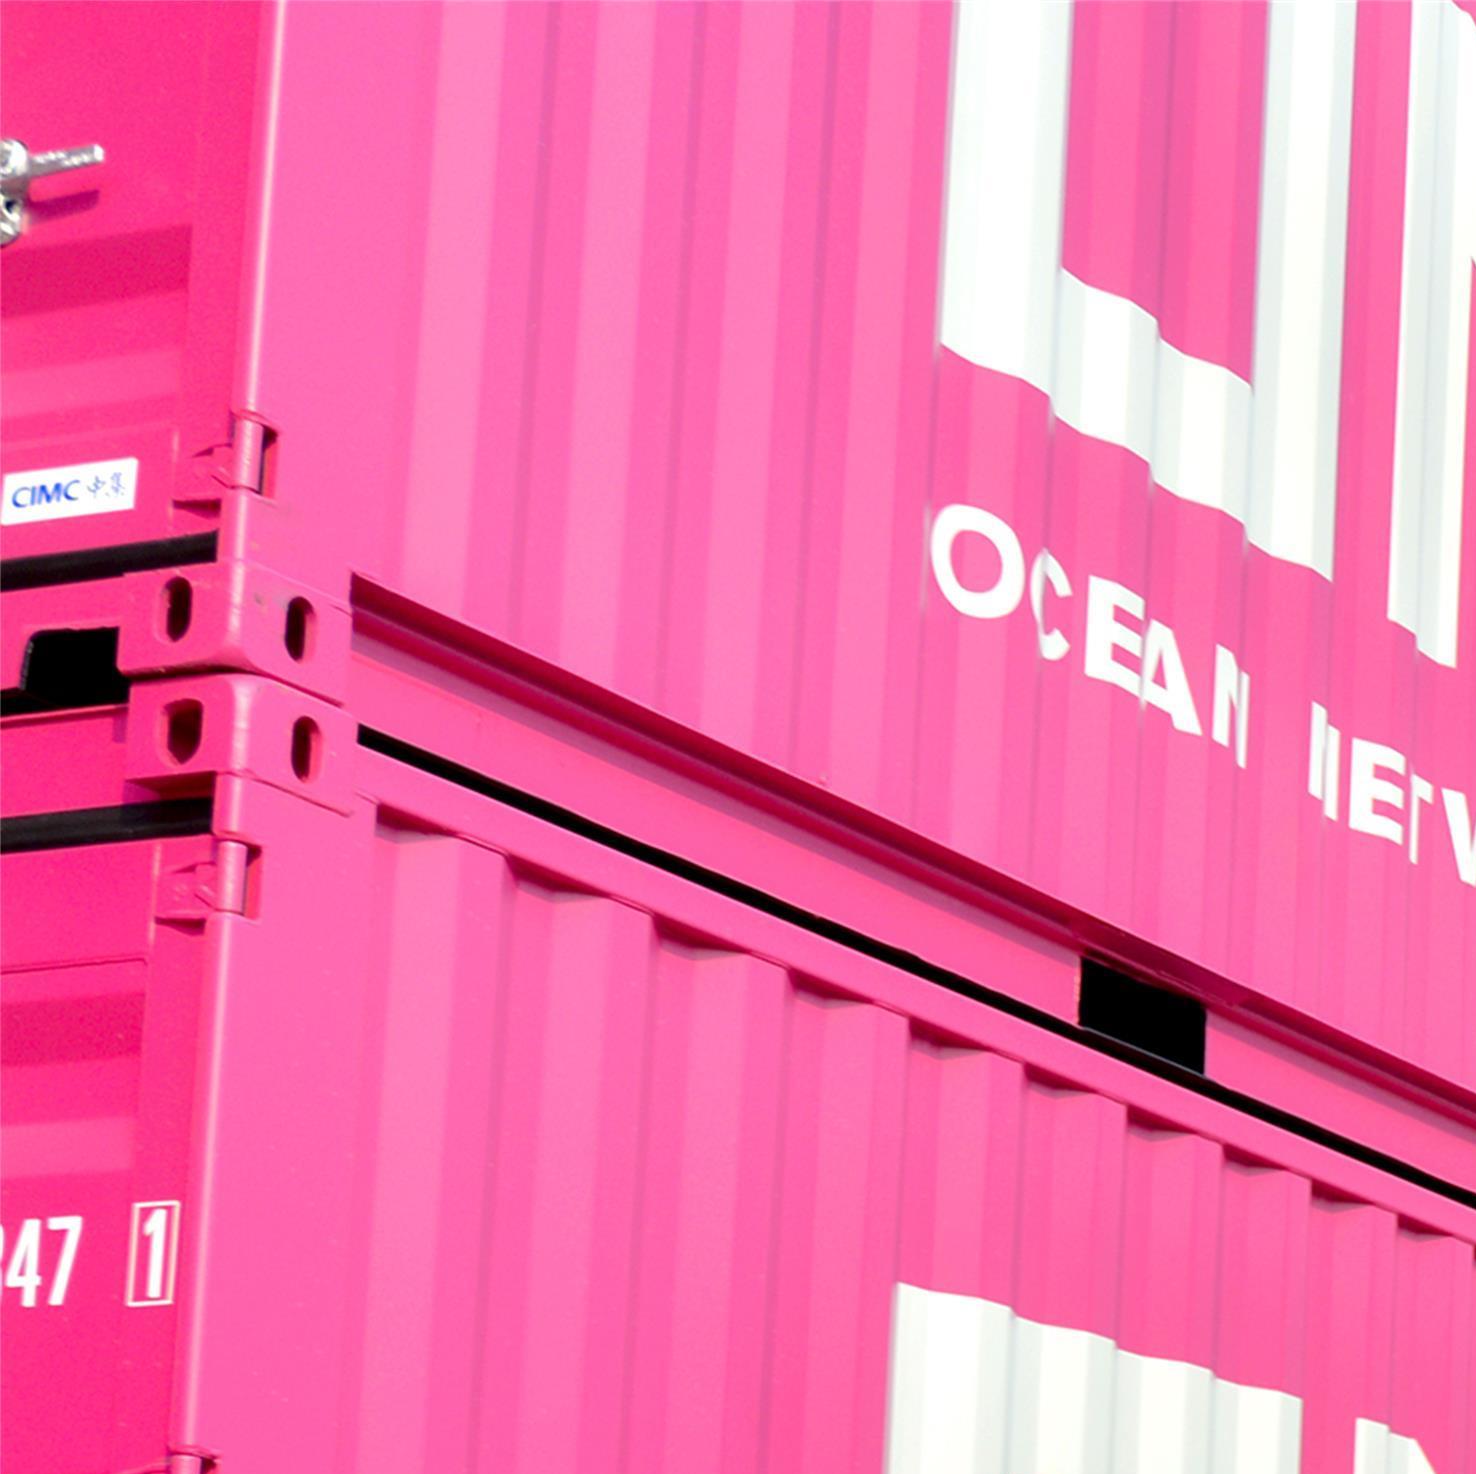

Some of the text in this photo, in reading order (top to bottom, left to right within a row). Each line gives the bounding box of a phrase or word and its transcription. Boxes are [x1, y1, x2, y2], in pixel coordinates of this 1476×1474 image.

[12, 480, 80, 509] CIMC
[931, 503, 1250, 769] OCEAN
[0, 1216, 83, 1308] 47
